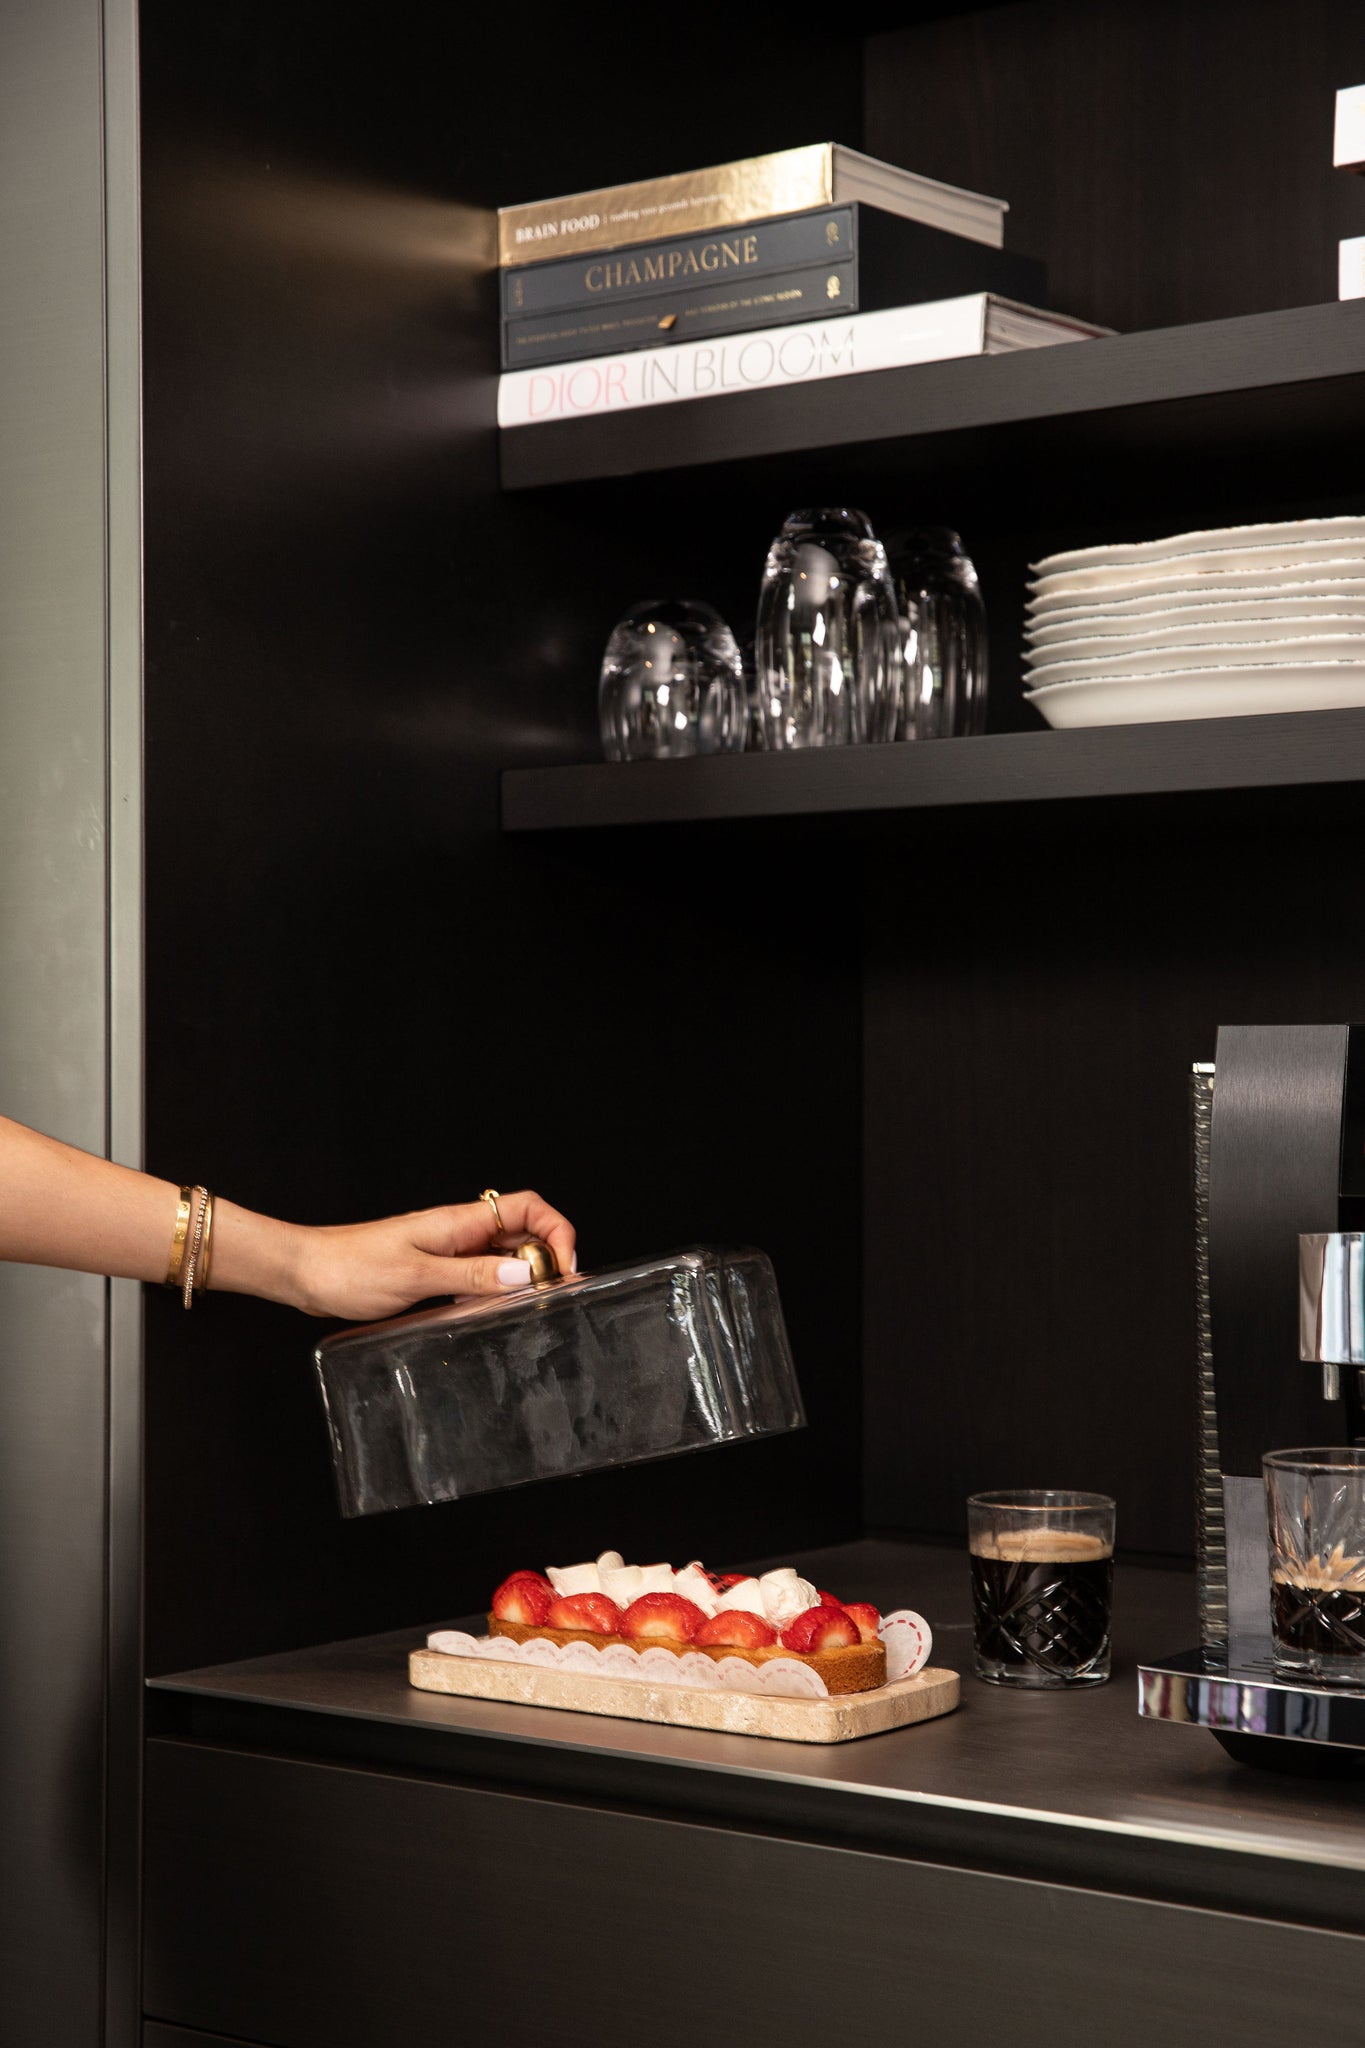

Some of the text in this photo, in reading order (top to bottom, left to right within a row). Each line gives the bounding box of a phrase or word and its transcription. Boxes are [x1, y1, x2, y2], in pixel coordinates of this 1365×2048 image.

[515, 221, 558, 244] BRAIN
[560, 213, 601, 236] FOOD
[585, 236, 759, 291] CHAMPAGNE
[527, 361, 631, 419] DIOR
[640, 353, 679, 401] IN
[694, 327, 853, 392] BLOOM
